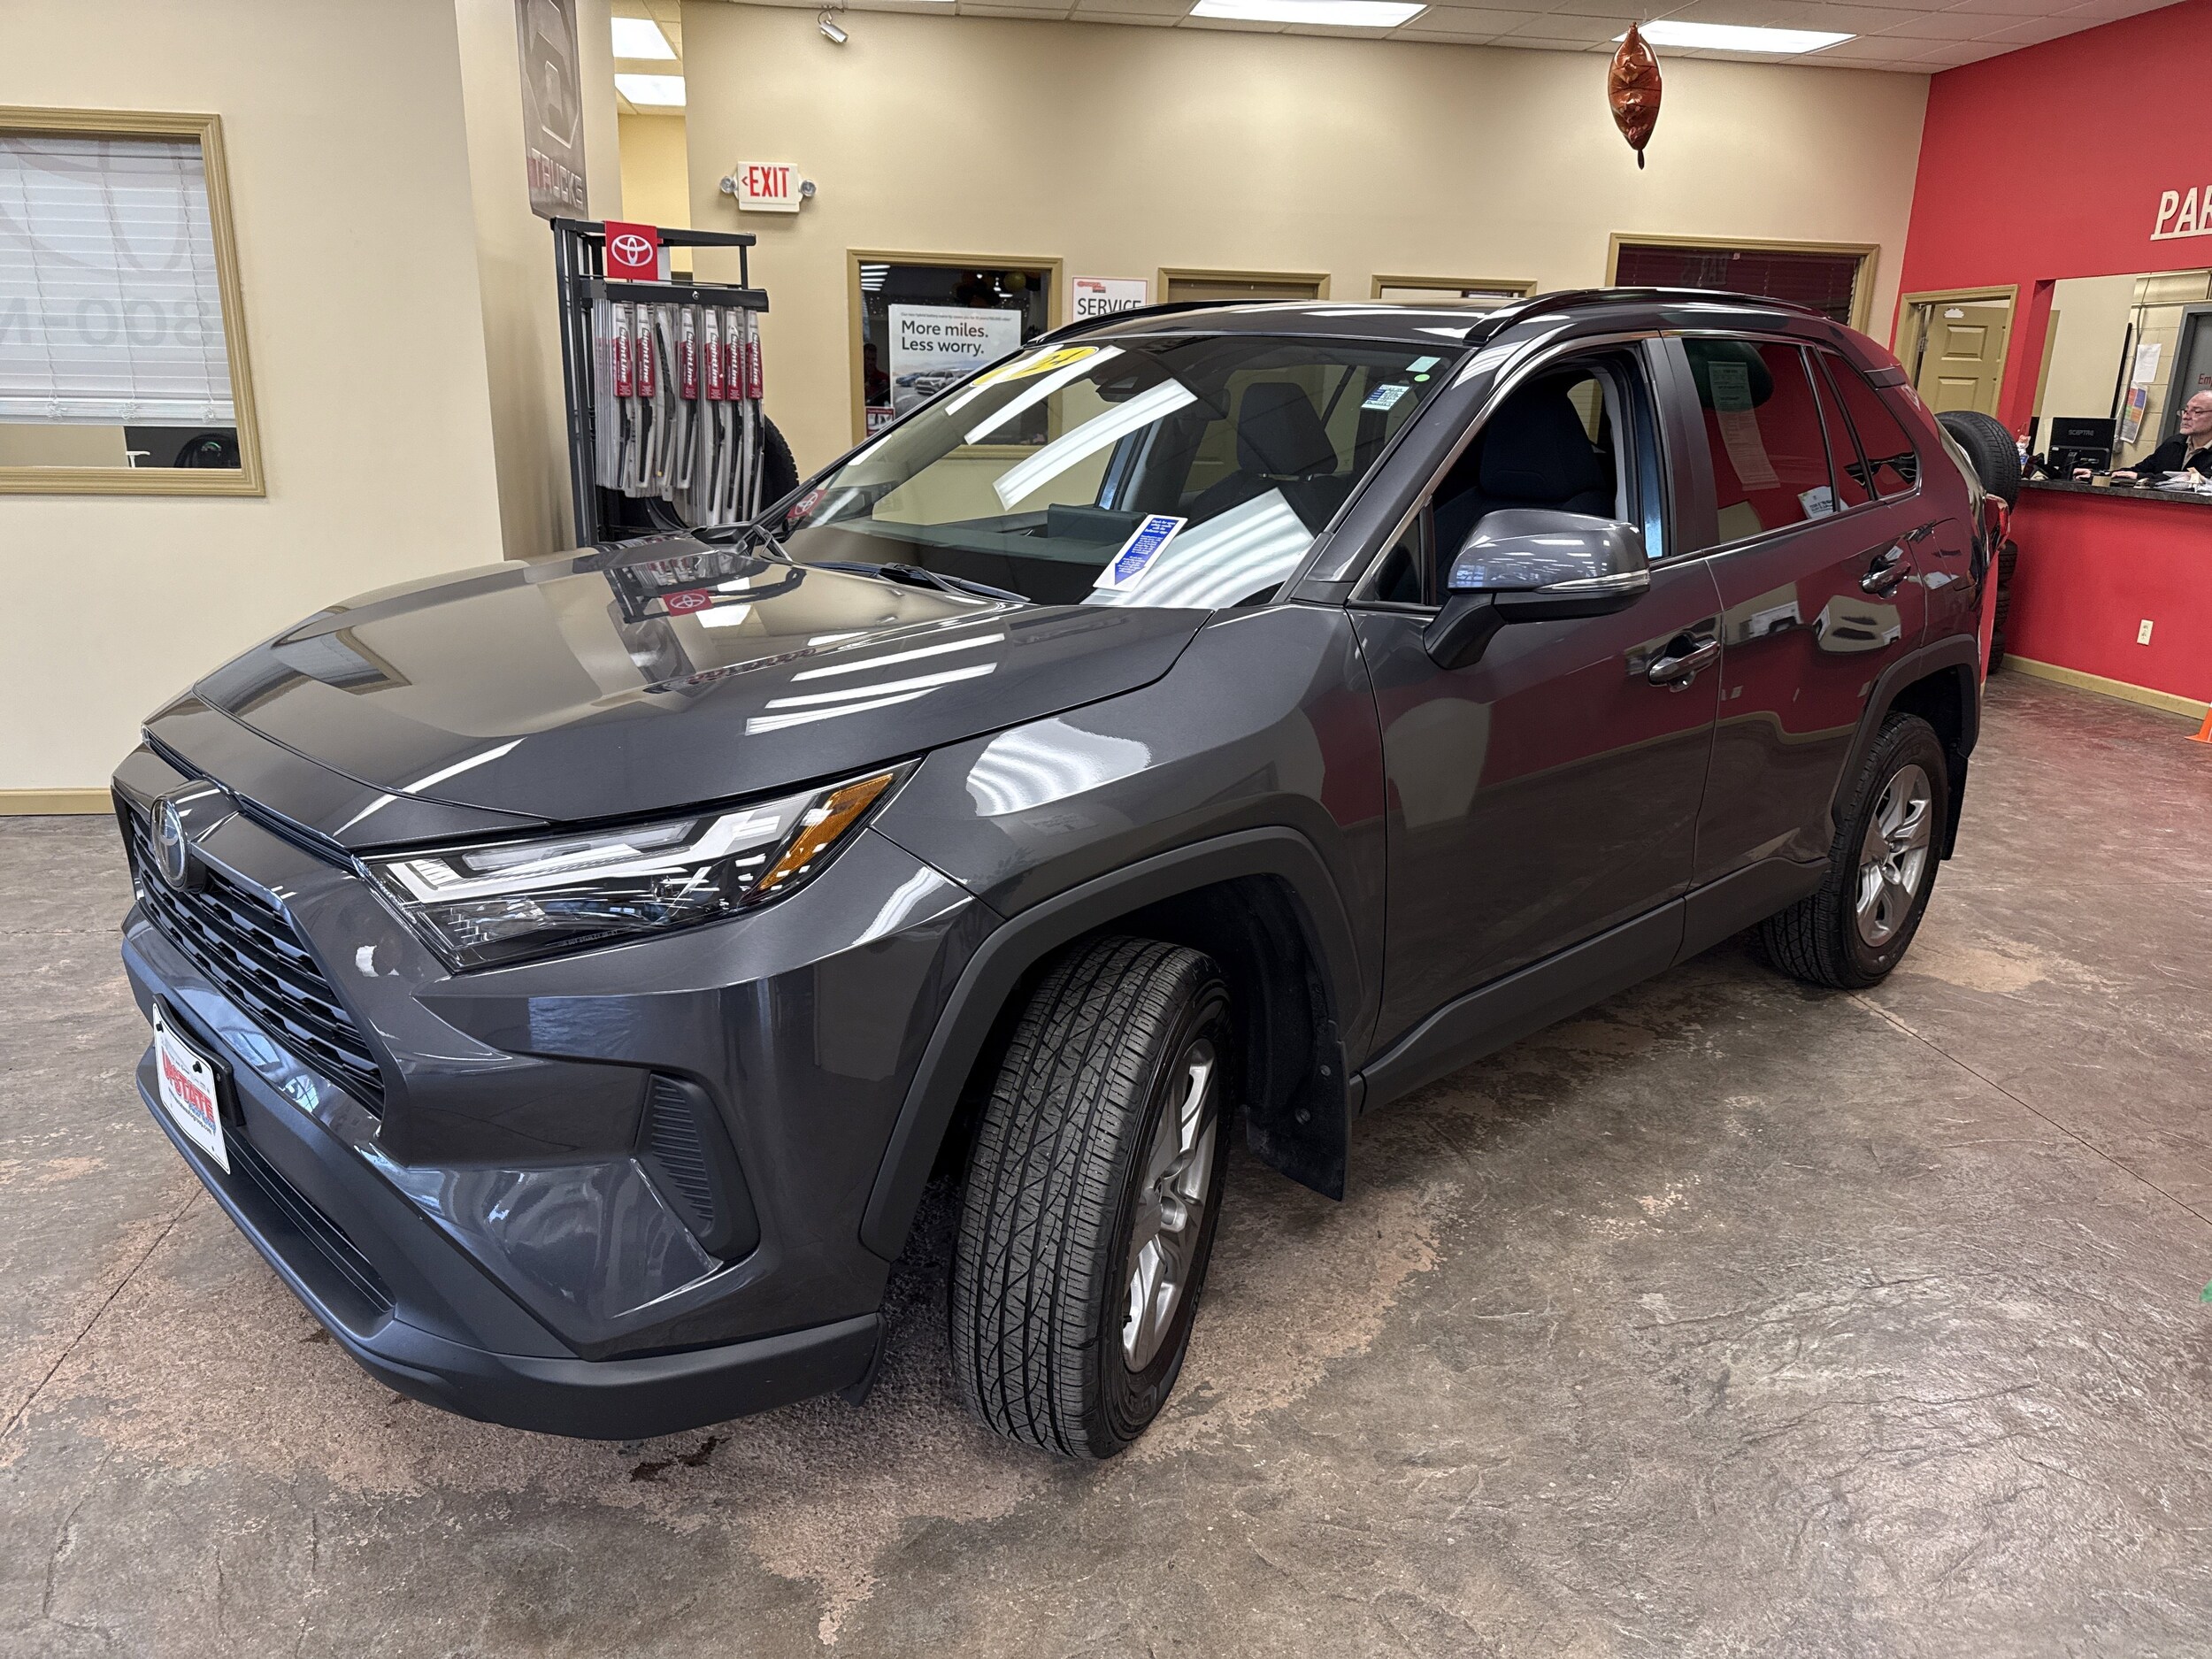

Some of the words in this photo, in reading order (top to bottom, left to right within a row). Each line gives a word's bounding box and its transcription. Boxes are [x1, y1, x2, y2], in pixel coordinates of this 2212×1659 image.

[531, 147, 584, 211] TRUCKS
[749, 165, 790, 198] EXIT
[902, 319, 941, 335] More
[945, 322, 989, 338] miles.
[902, 336, 934, 351] Less
[938, 341, 985, 357] worry.
